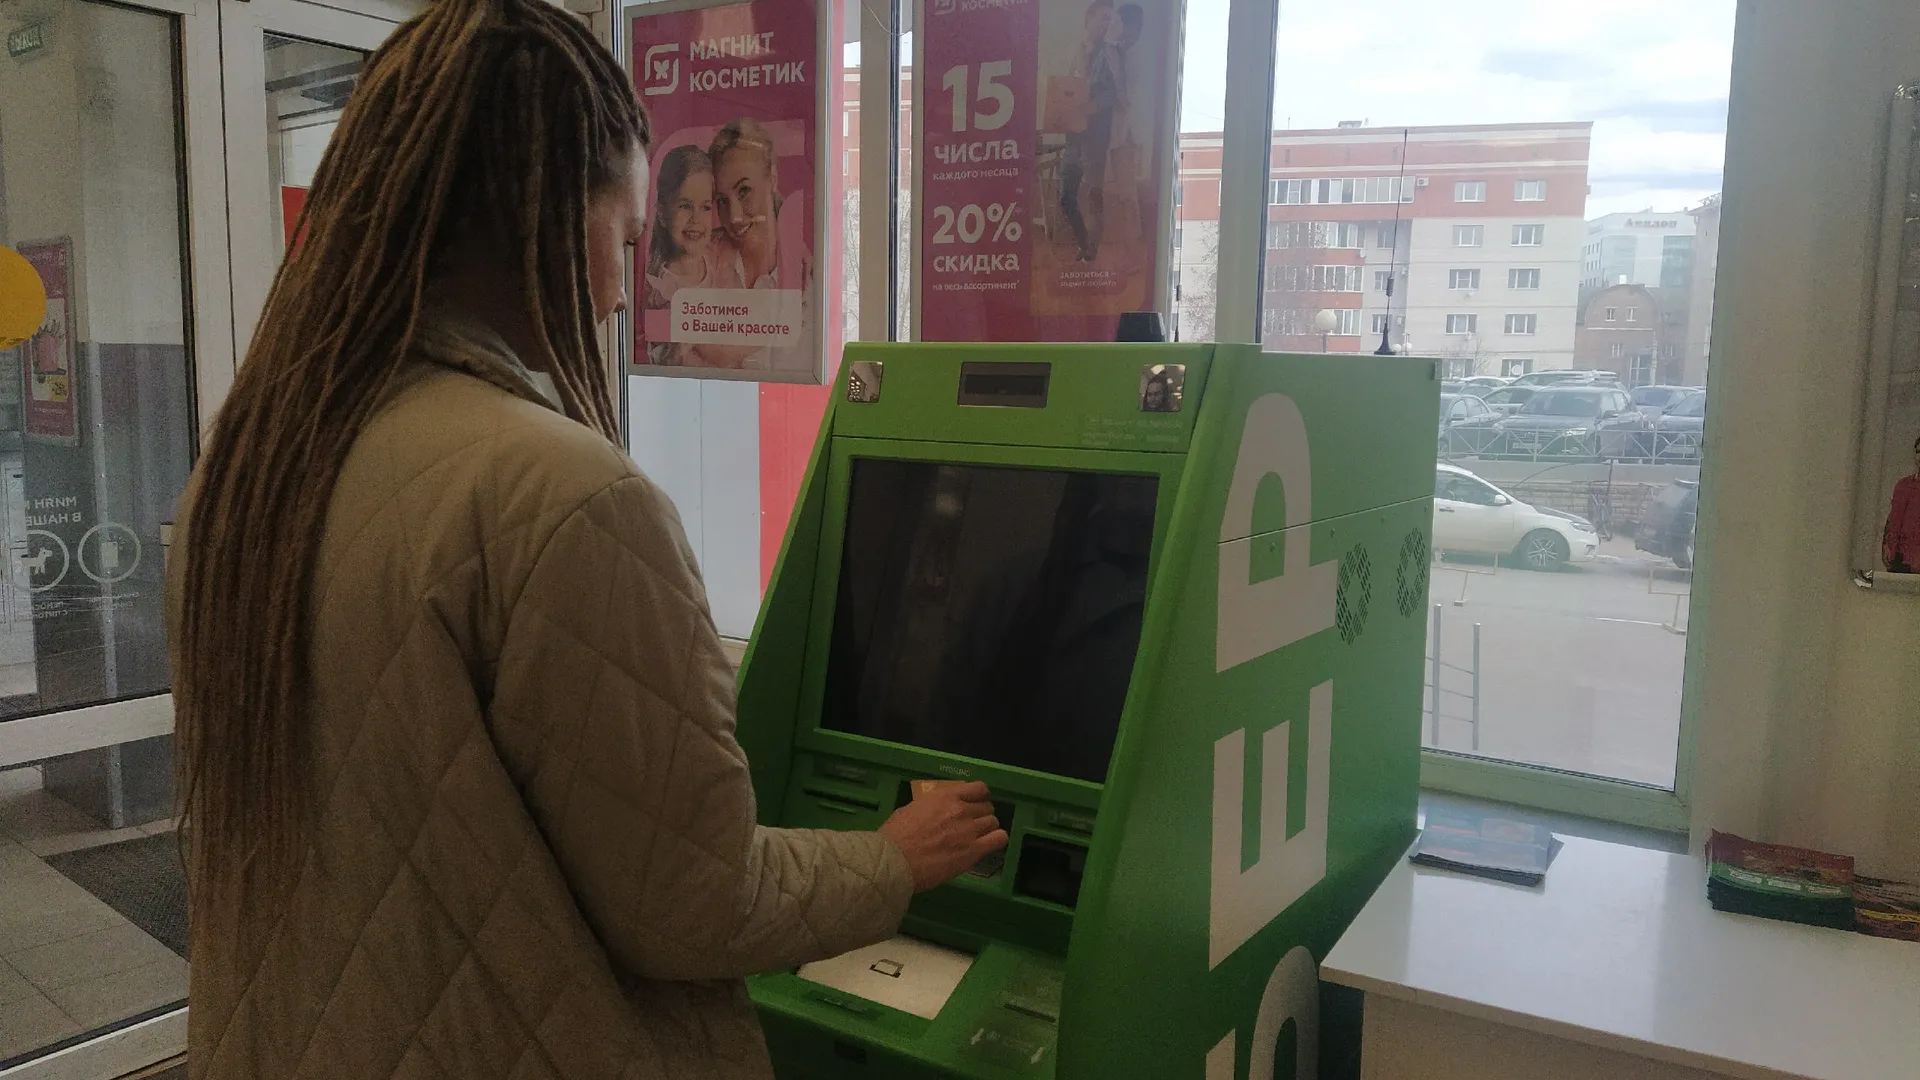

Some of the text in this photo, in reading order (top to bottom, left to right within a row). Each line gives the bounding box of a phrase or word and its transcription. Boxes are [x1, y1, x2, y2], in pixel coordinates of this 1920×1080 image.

[961, 0, 1030, 12] КОСМЕ
[689, 31, 774, 61] МАГНИТ
[689, 61, 806, 93] КОСМЕТИК
[942, 59, 1015, 133] 15
[933, 139, 1021, 165] числа
[932, 167, 1020, 181] каждого месяца
[932, 200, 1023, 245] 20%
[933, 253, 1021, 275] скидка
[932, 283, 943, 291] на
[681, 301, 749, 316] Заботимся
[681, 318, 790, 337] о Вашей красоте
